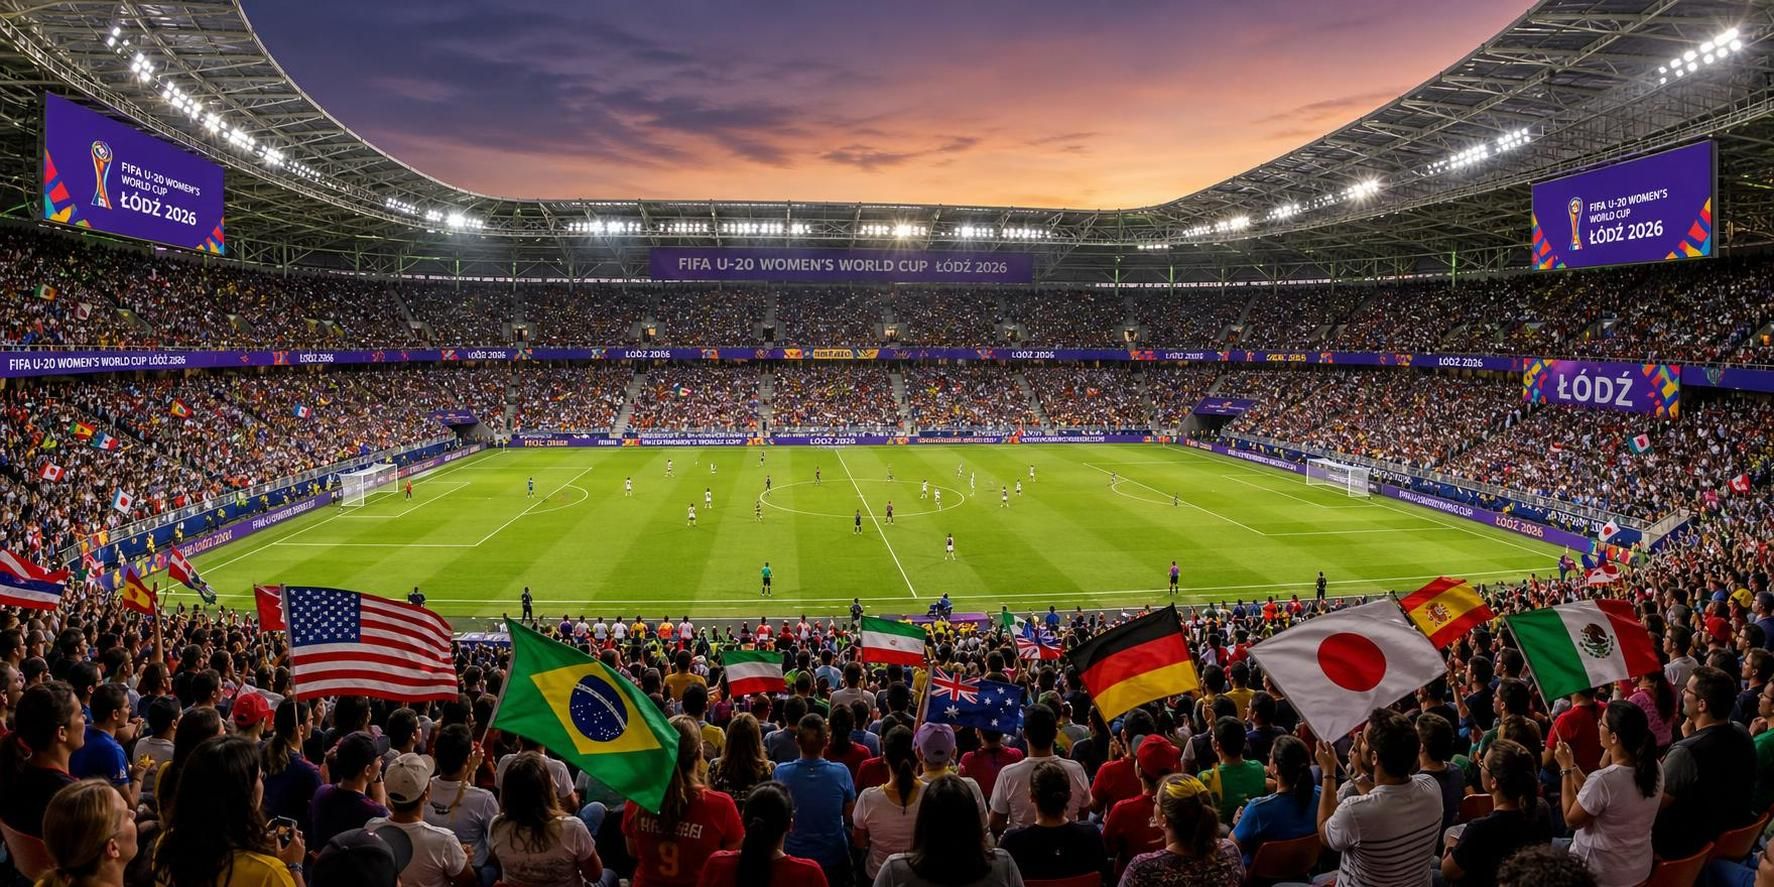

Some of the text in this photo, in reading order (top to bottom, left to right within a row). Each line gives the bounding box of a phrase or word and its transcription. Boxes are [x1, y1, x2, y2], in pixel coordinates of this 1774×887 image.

[121, 162, 201, 196] FIFA U-20 WOMEN'S
[121, 175, 168, 196] WORLD CUP
[1589, 188, 1668, 212] FIFA U-20 WOMEN'S
[165, 204, 197, 226] 2026
[1589, 208, 1631, 224] WORLD CUP
[1627, 220, 1664, 240] 2026
[678, 257, 1008, 273] FIFA U-20 WOMEN'S WORLD CUP ŁÓDŹ 2026
[9, 358, 32, 371] FIFA
[33, 358, 56, 370] U-20
[57, 356, 100, 369] WOMEN'S
[101, 356, 130, 367] WORLD
[131, 356, 147, 366] CUP
[1462, 358, 1484, 367] 2026
[1557, 368, 1635, 407] ŁÓDŹ
[1520, 522, 1544, 538] 2026
[658, 841, 680, 878] 9
